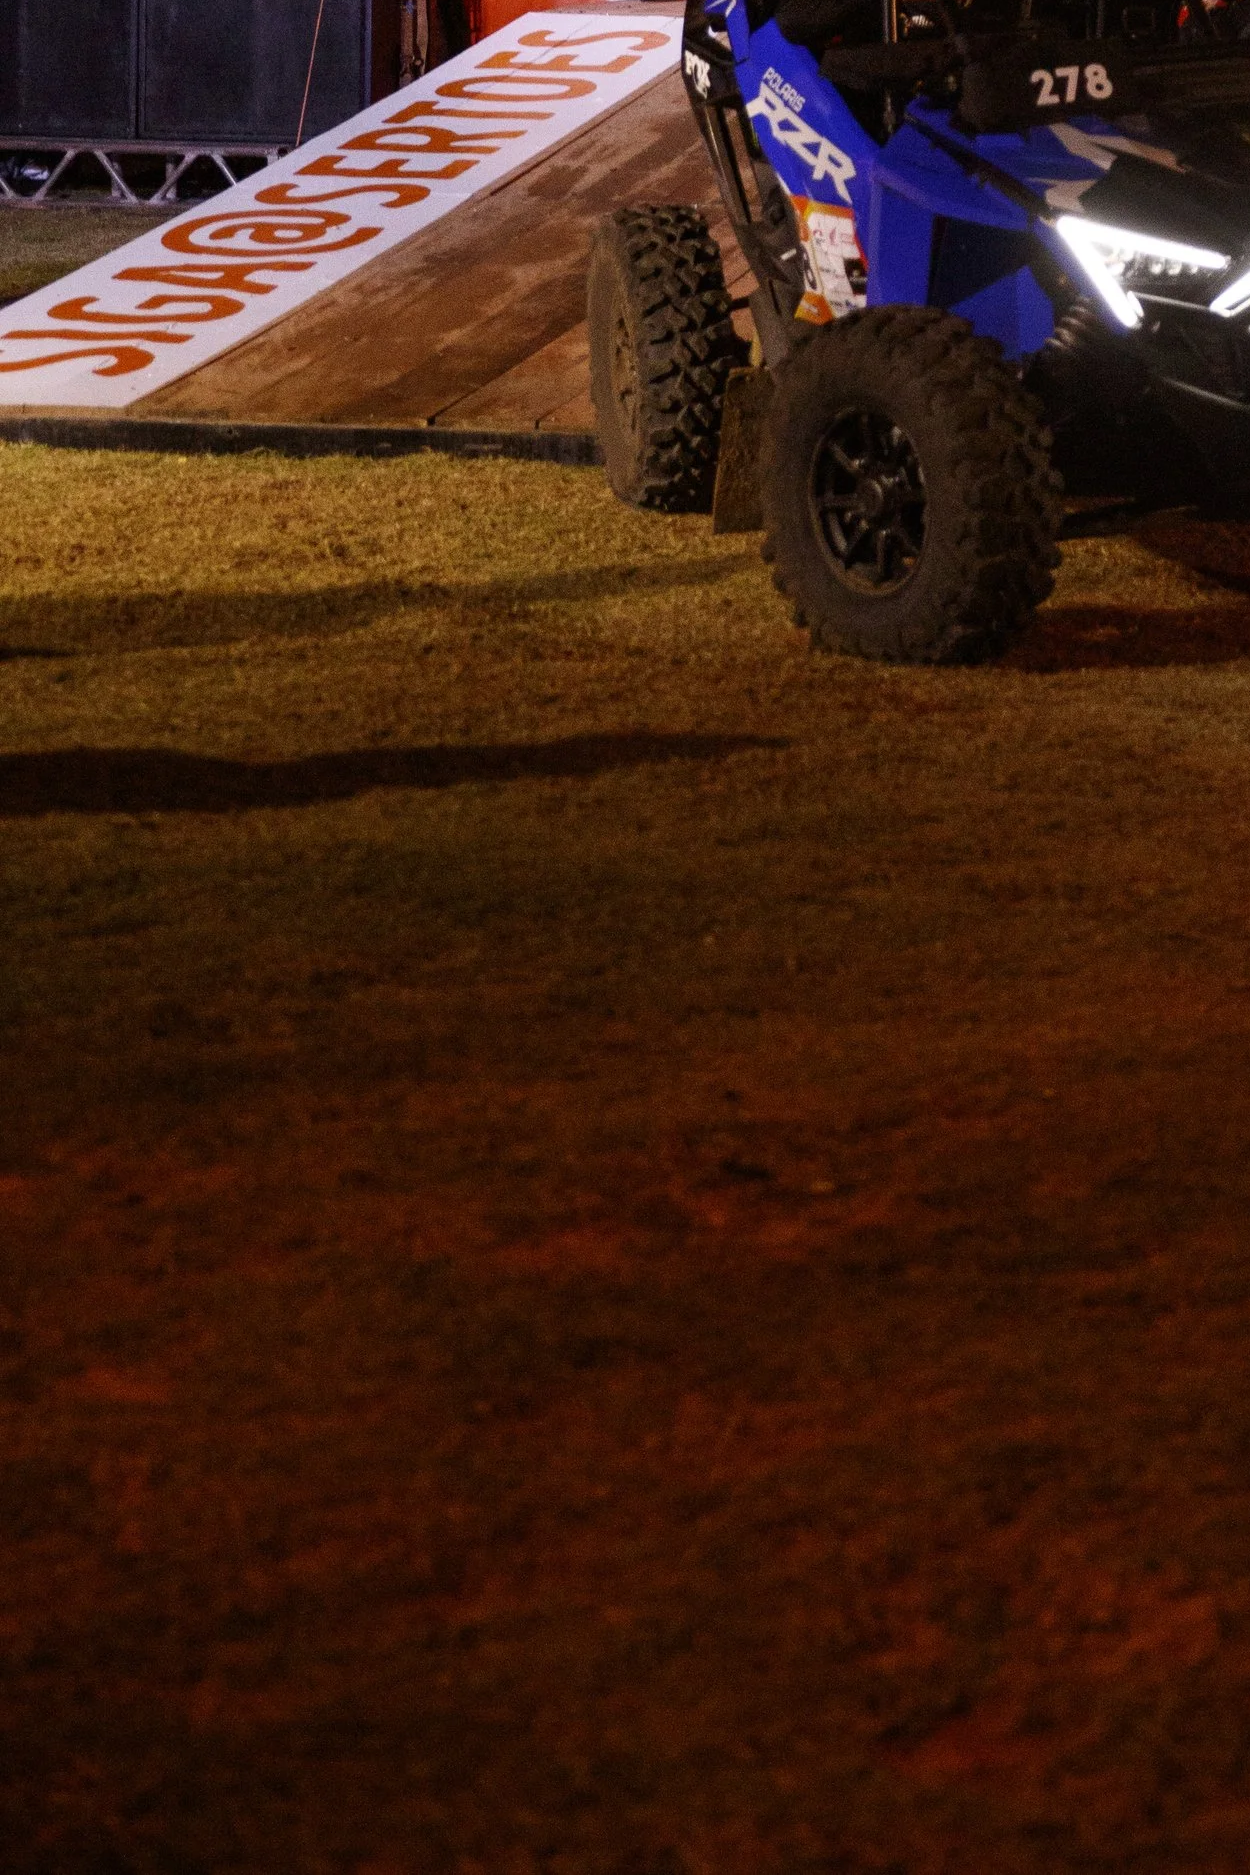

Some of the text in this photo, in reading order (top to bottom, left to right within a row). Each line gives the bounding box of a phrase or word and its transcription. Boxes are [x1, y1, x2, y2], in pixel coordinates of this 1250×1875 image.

[763, 66, 806, 113] POLARIS
[1029, 64, 1114, 106] 278
[745, 80, 856, 204] RZR
